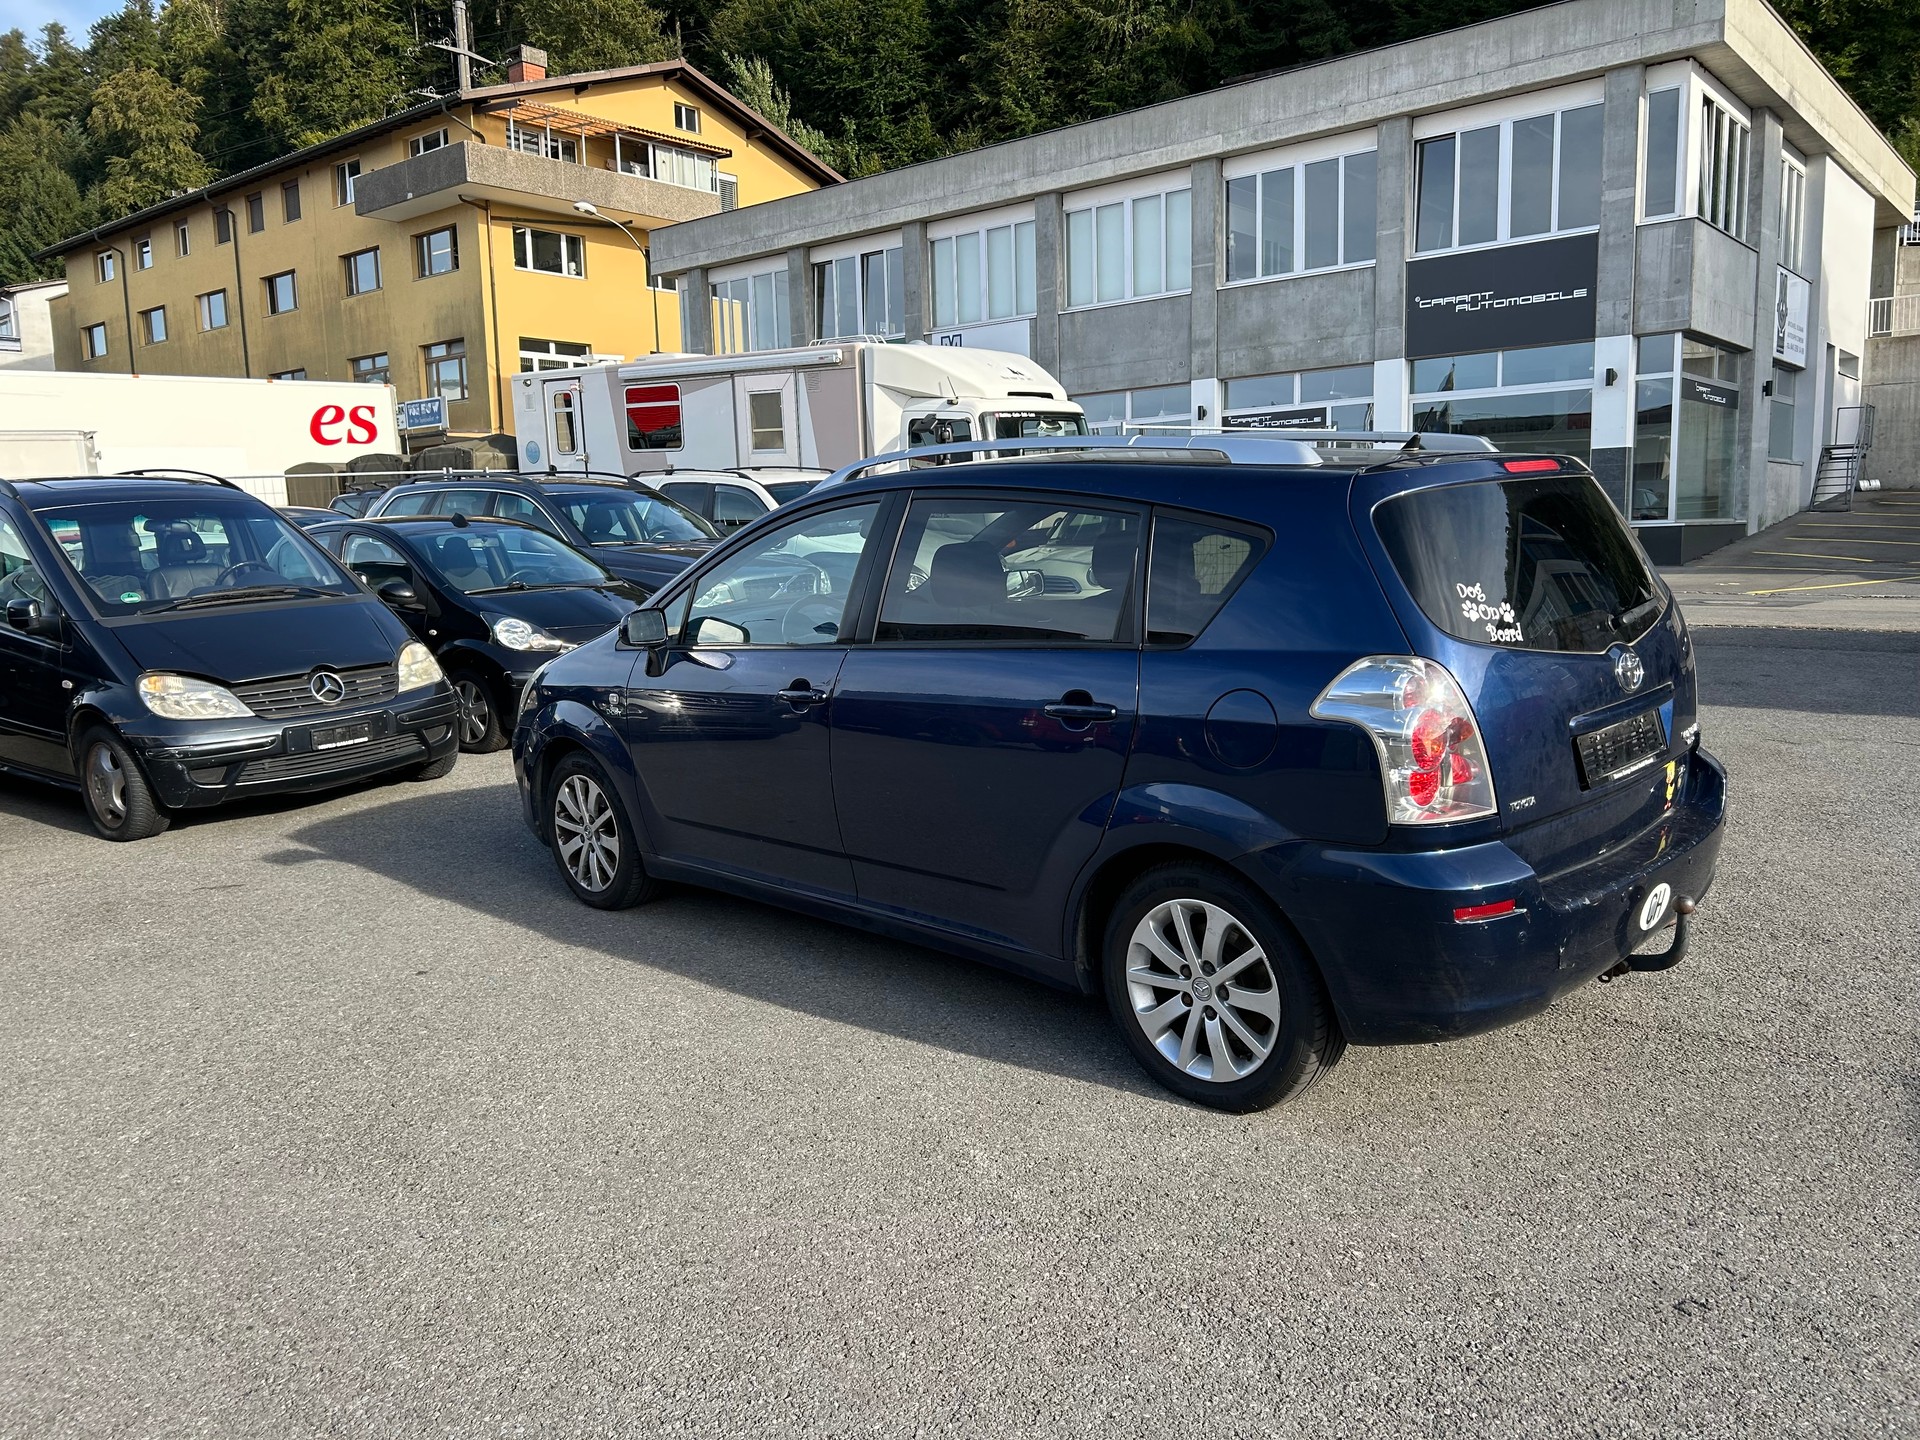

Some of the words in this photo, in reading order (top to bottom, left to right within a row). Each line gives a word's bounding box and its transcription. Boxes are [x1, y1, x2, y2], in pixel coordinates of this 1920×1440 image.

[1419, 291, 1494, 308] CARANT
[1455, 288, 1588, 312] AUTOMOBILE
[309, 404, 378, 446] es
[1250, 416, 1322, 428] AUTOMOBILE
[1456, 582, 1487, 602] Dog
[1478, 603, 1500, 620] On
[1485, 622, 1524, 642] Board
[1645, 887, 1668, 925] CH
